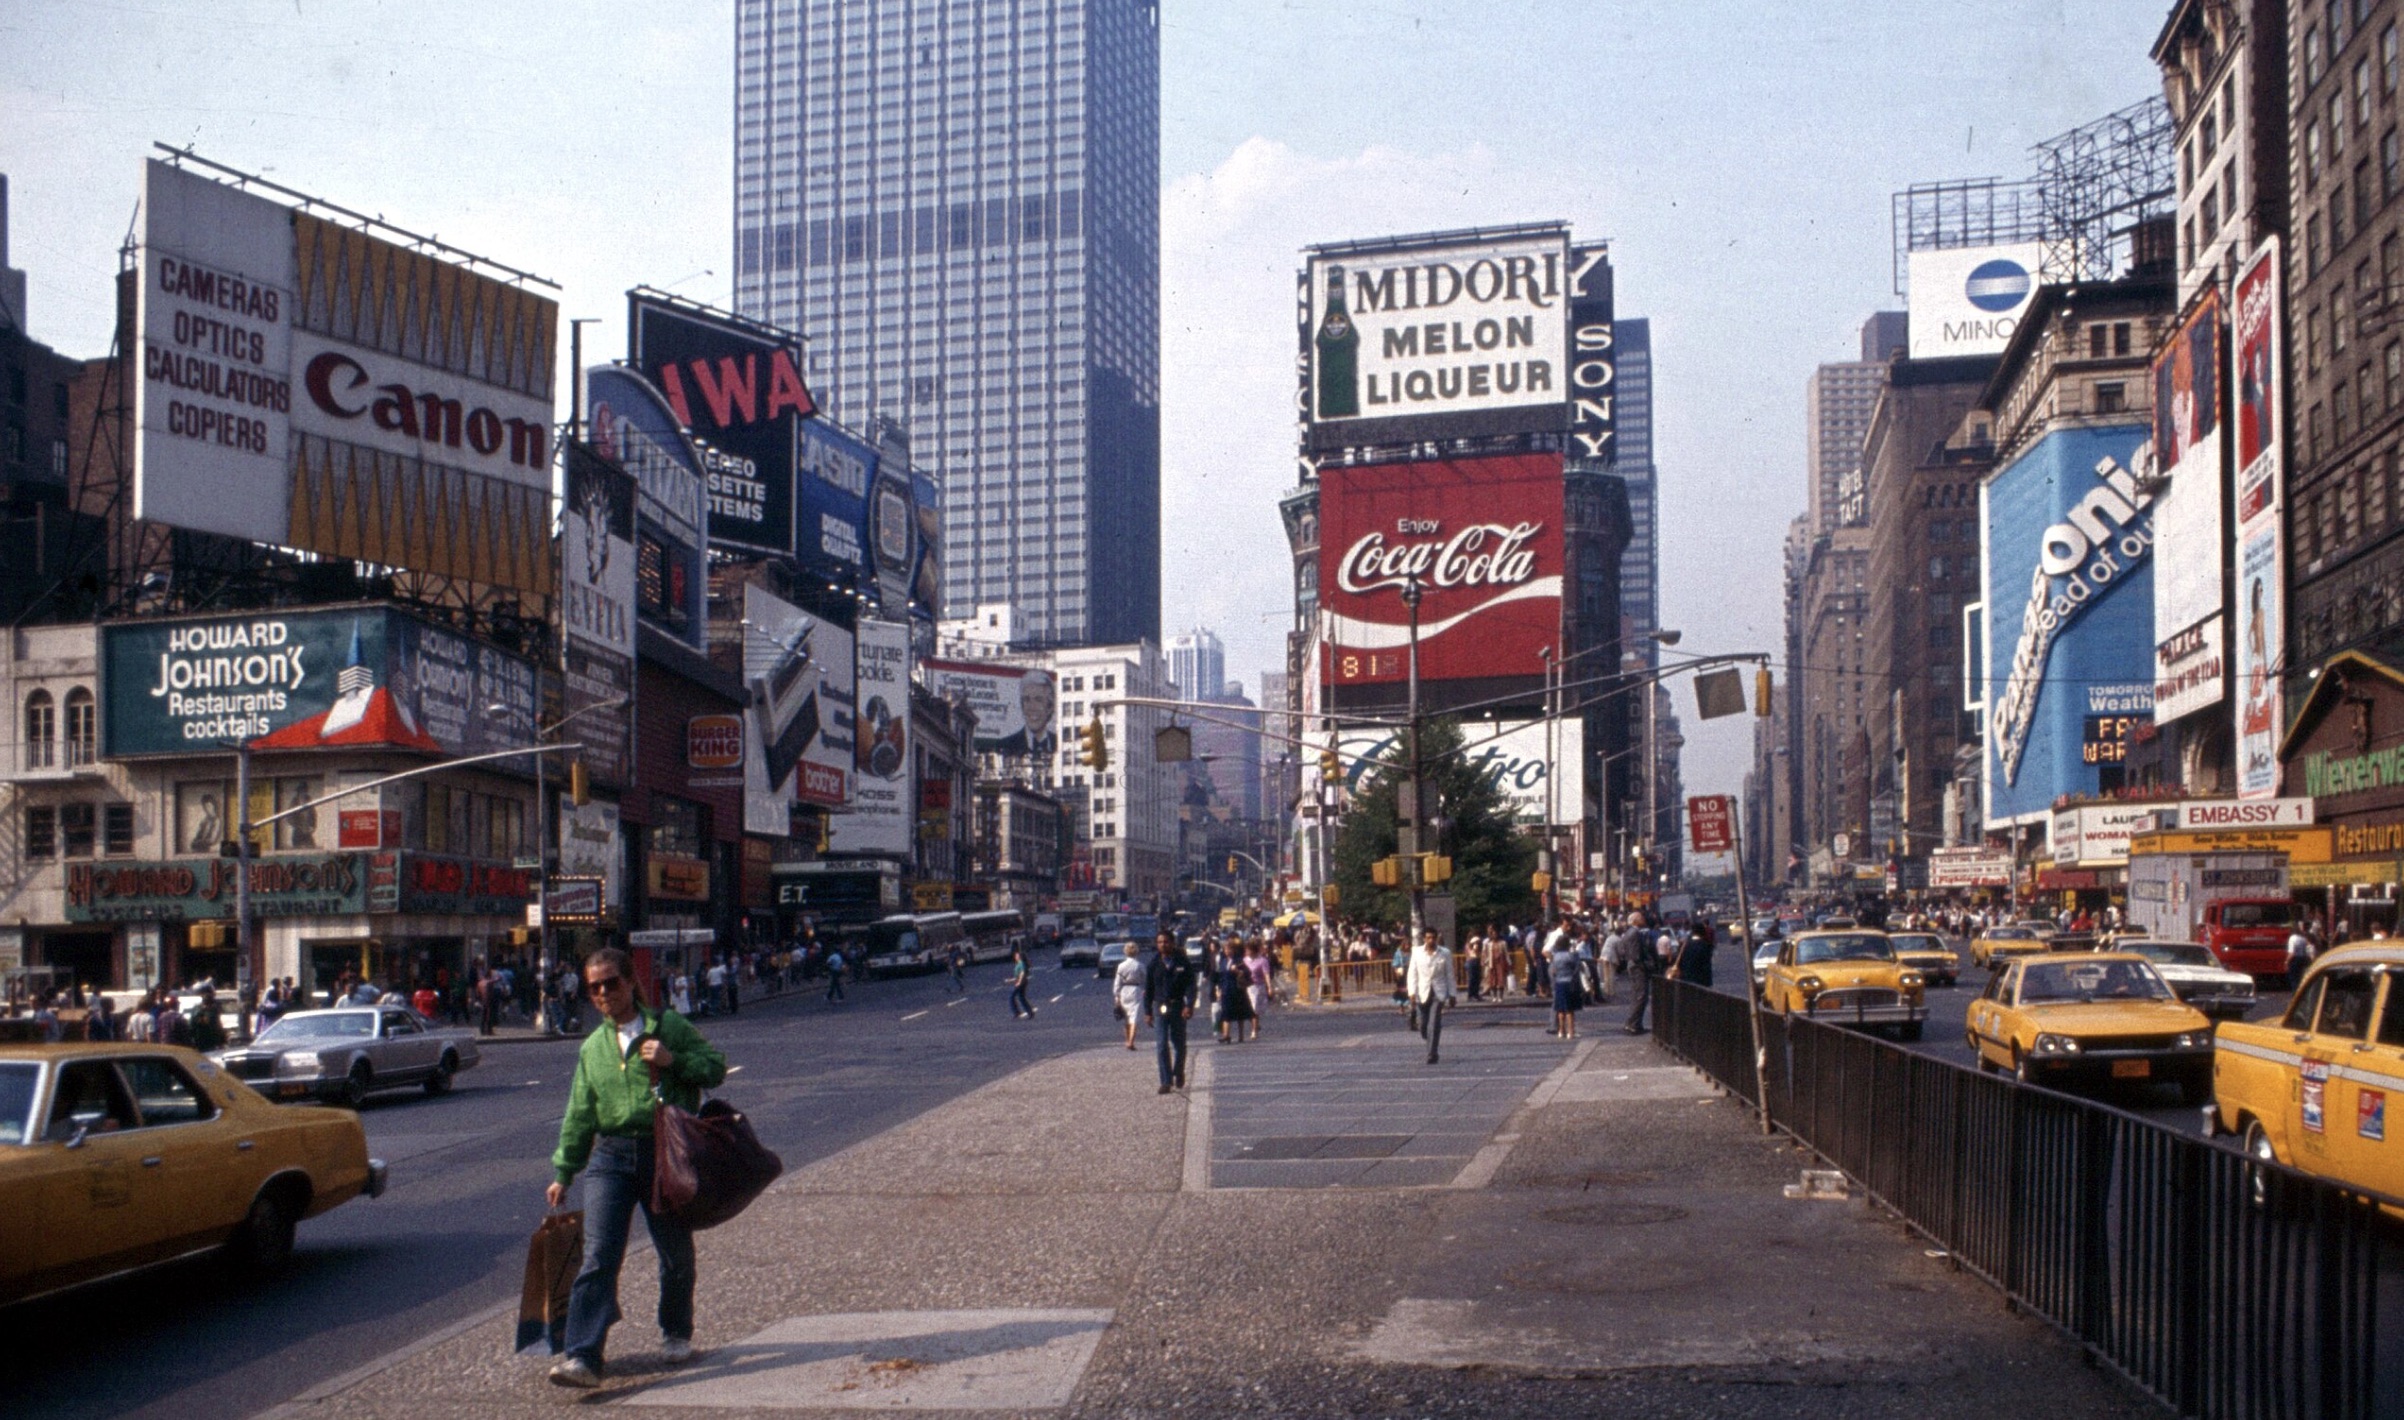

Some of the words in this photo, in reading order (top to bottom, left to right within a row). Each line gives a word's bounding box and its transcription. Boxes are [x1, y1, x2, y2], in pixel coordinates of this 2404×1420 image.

[160, 257, 279, 323] CAMERAS
[1354, 252, 1560, 314] MIDORI
[174, 311, 264, 365] OPTICS
[1383, 316, 1533, 359] MELON
[145, 345, 291, 414] CALCULATORS
[1367, 360, 1552, 405] LIQUEUR
[1573, 323, 1614, 458] SONY
[305, 351, 546, 470] Canon
[168, 401, 266, 454] COPIERS
[801, 431, 866, 498] ASIO
[1397, 518, 1440, 533] Enjoy
[1338, 521, 1543, 594] Coca-Cola
[2089, 545, 2119, 584] of
[170, 621, 287, 652] HOWARD
[150, 646, 305, 697] JOHNSON'S
[168, 690, 287, 716] Restaurants
[2088, 685, 2152, 696] TOMORRO
[2090, 695, 2152, 711] Weath
[183, 713, 270, 739] cocktails
[690, 726, 740, 739] BURGER
[2099, 717, 2138, 738] FA
[690, 739, 740, 756] KING
[805, 764, 841, 793] brother
[856, 789, 897, 800] KOSS
[1698, 800, 1718, 812] NO
[1701, 821, 1720, 829] ANY
[2189, 805, 2279, 825] EMBASSY
[2295, 804, 2304, 820] 1
[1701, 830, 1720, 838] TIME
[68, 862, 194, 905] HOWARD
[201, 854, 357, 901] JOHNSON'S
[217, 899, 342, 918] RSTAURANT
[779, 884, 809, 904] E.T.
